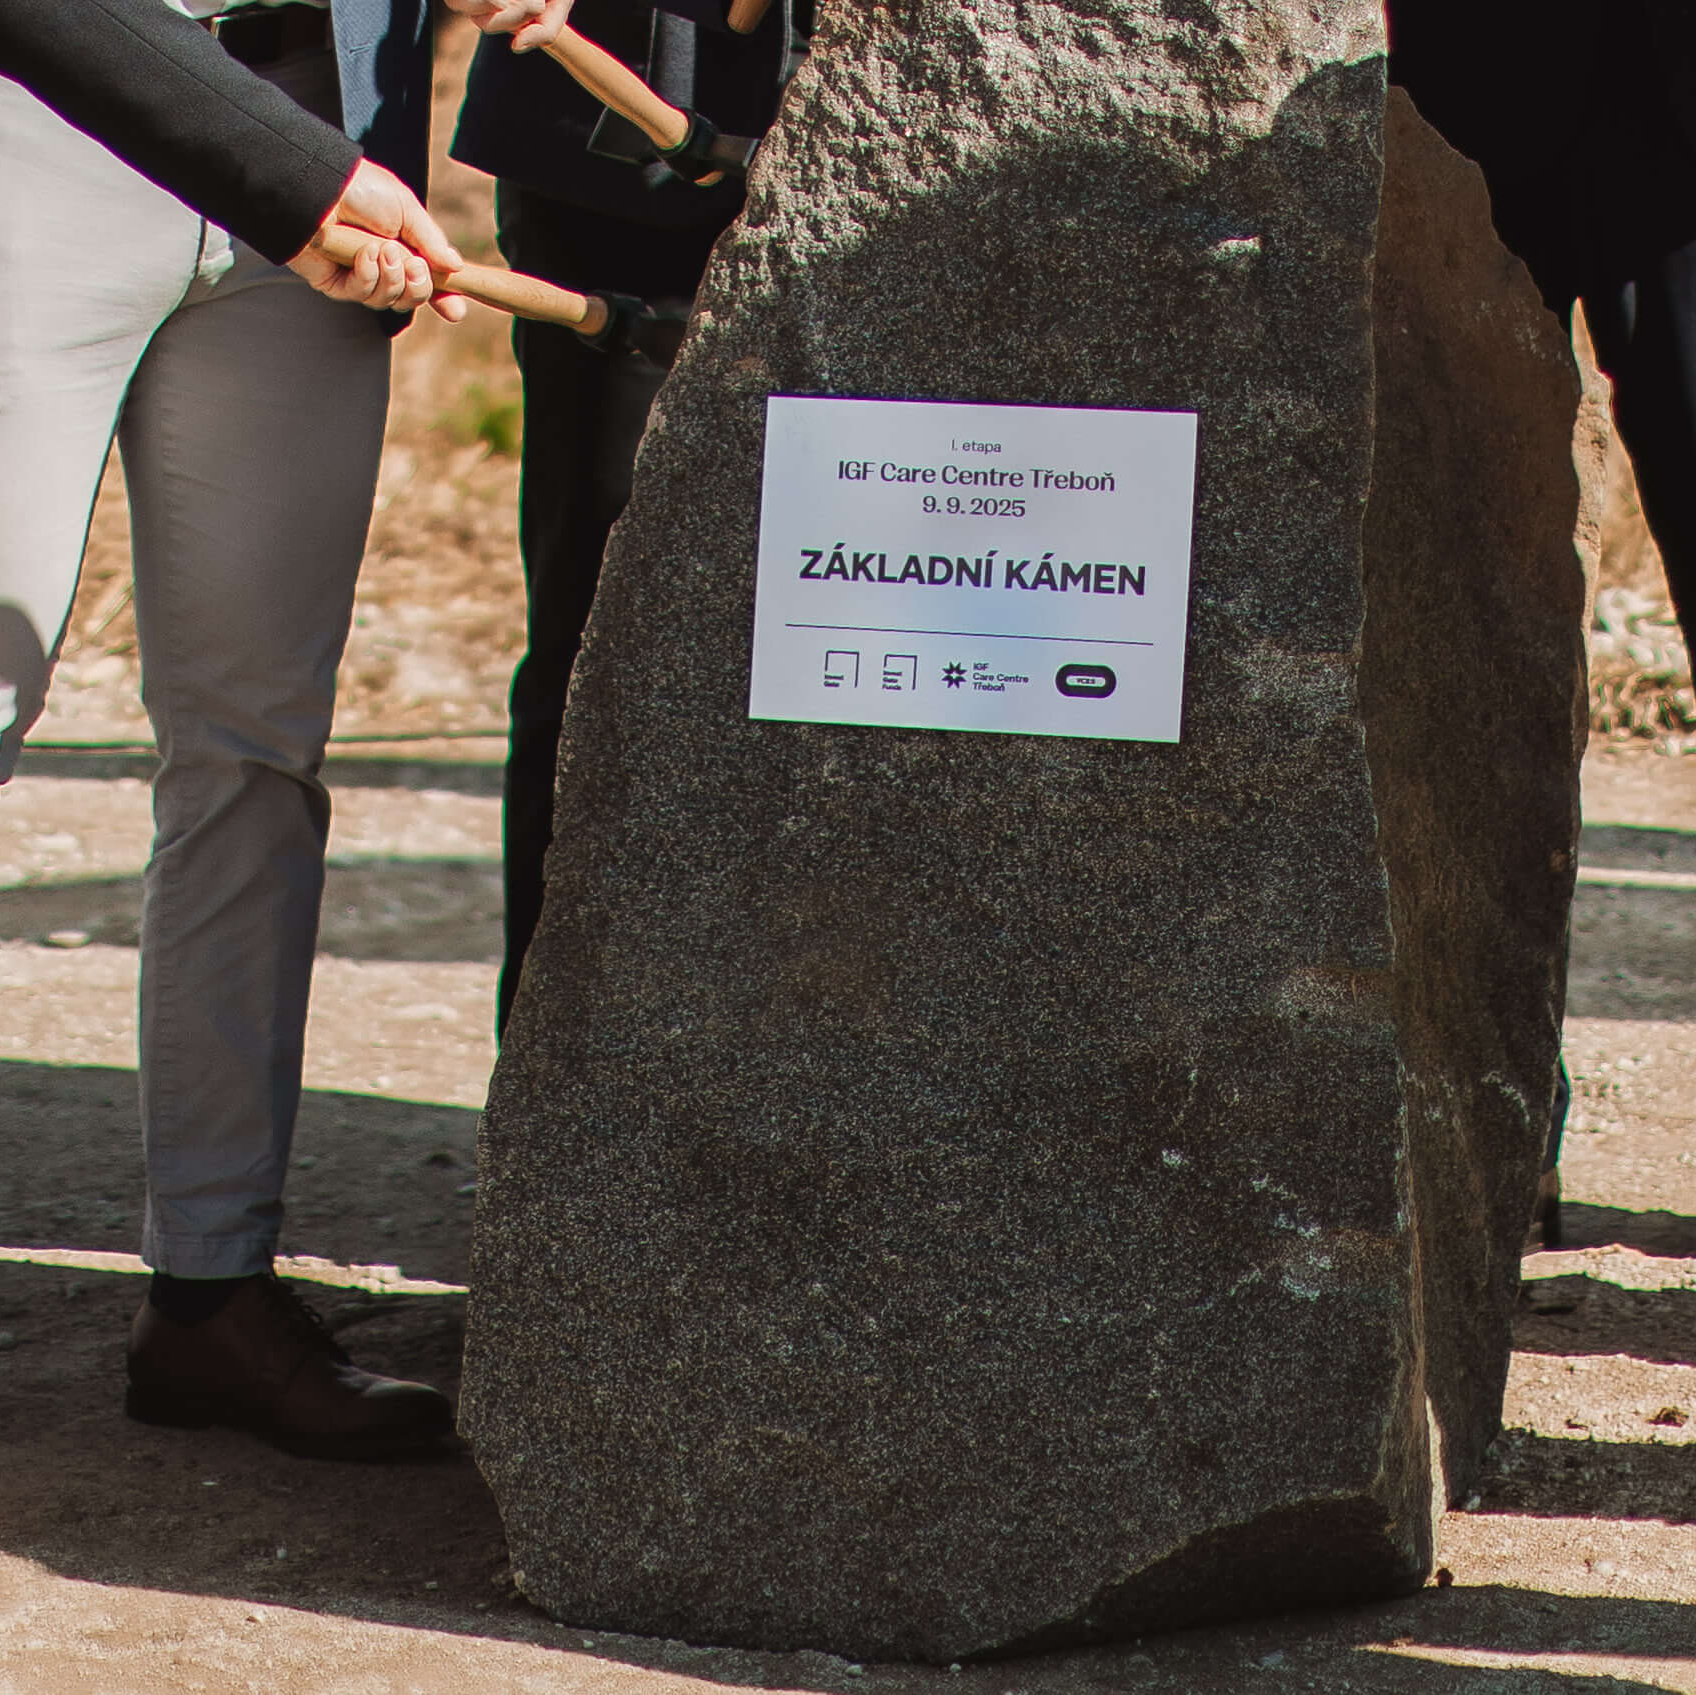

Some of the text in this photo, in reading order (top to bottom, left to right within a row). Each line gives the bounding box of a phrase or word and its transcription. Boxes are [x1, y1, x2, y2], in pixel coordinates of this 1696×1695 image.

[961, 440, 1002, 455] etapa
[838, 460, 1116, 492] IGF Care Centre Třeboň
[799, 542, 1146, 596] ZÁKLADNÍ KÁMEN
